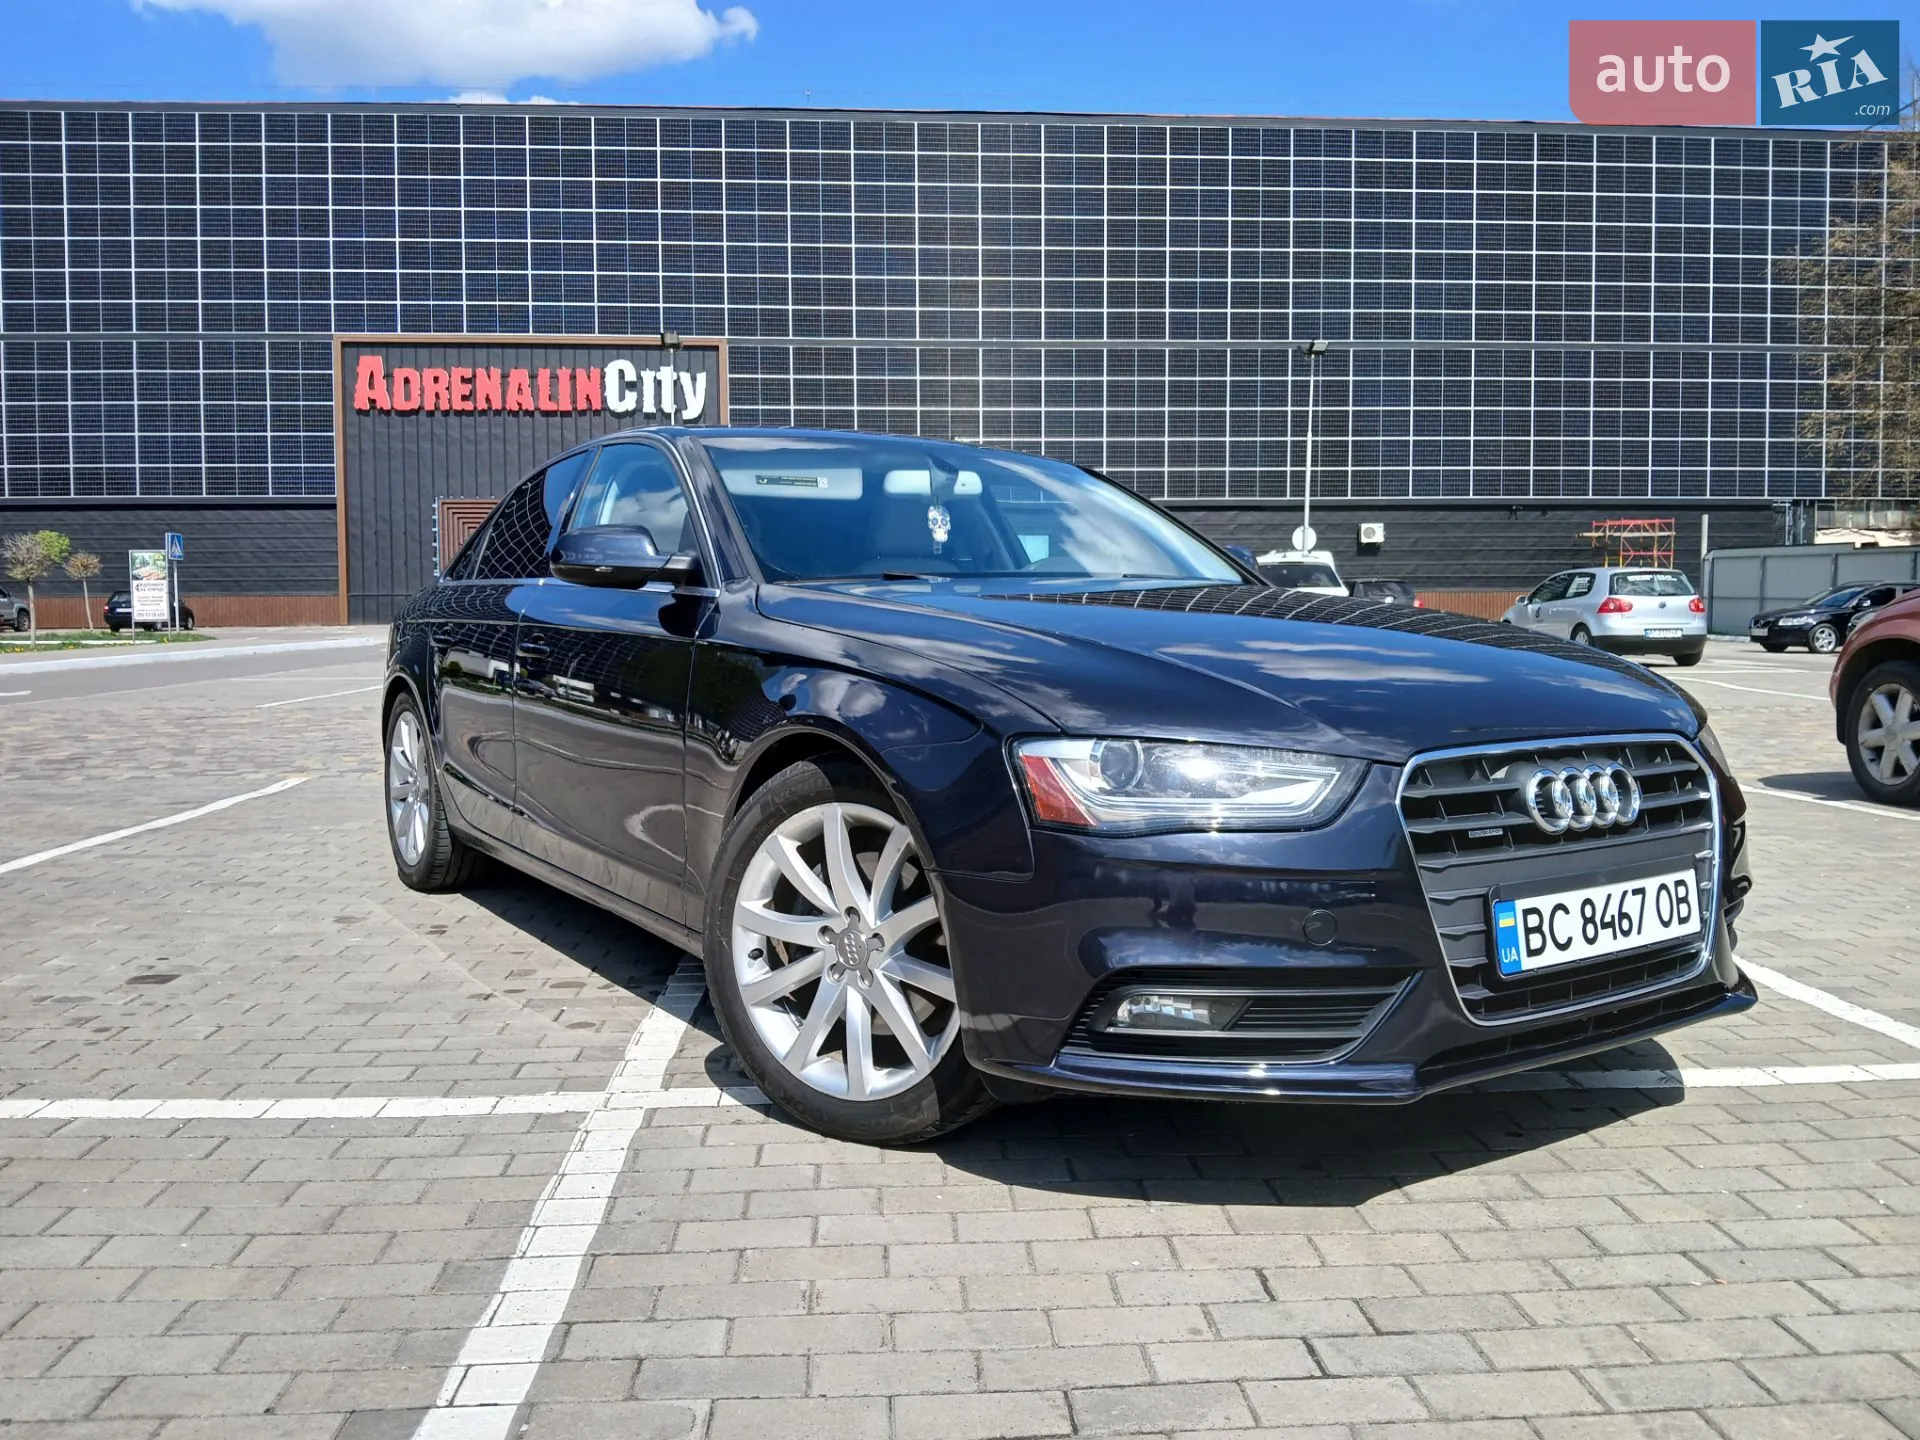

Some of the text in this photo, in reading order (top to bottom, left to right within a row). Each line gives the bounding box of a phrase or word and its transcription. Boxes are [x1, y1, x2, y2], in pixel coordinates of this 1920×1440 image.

[1522, 879, 1692, 958] BC 8467 OB
[1501, 947, 1519, 963] UA
